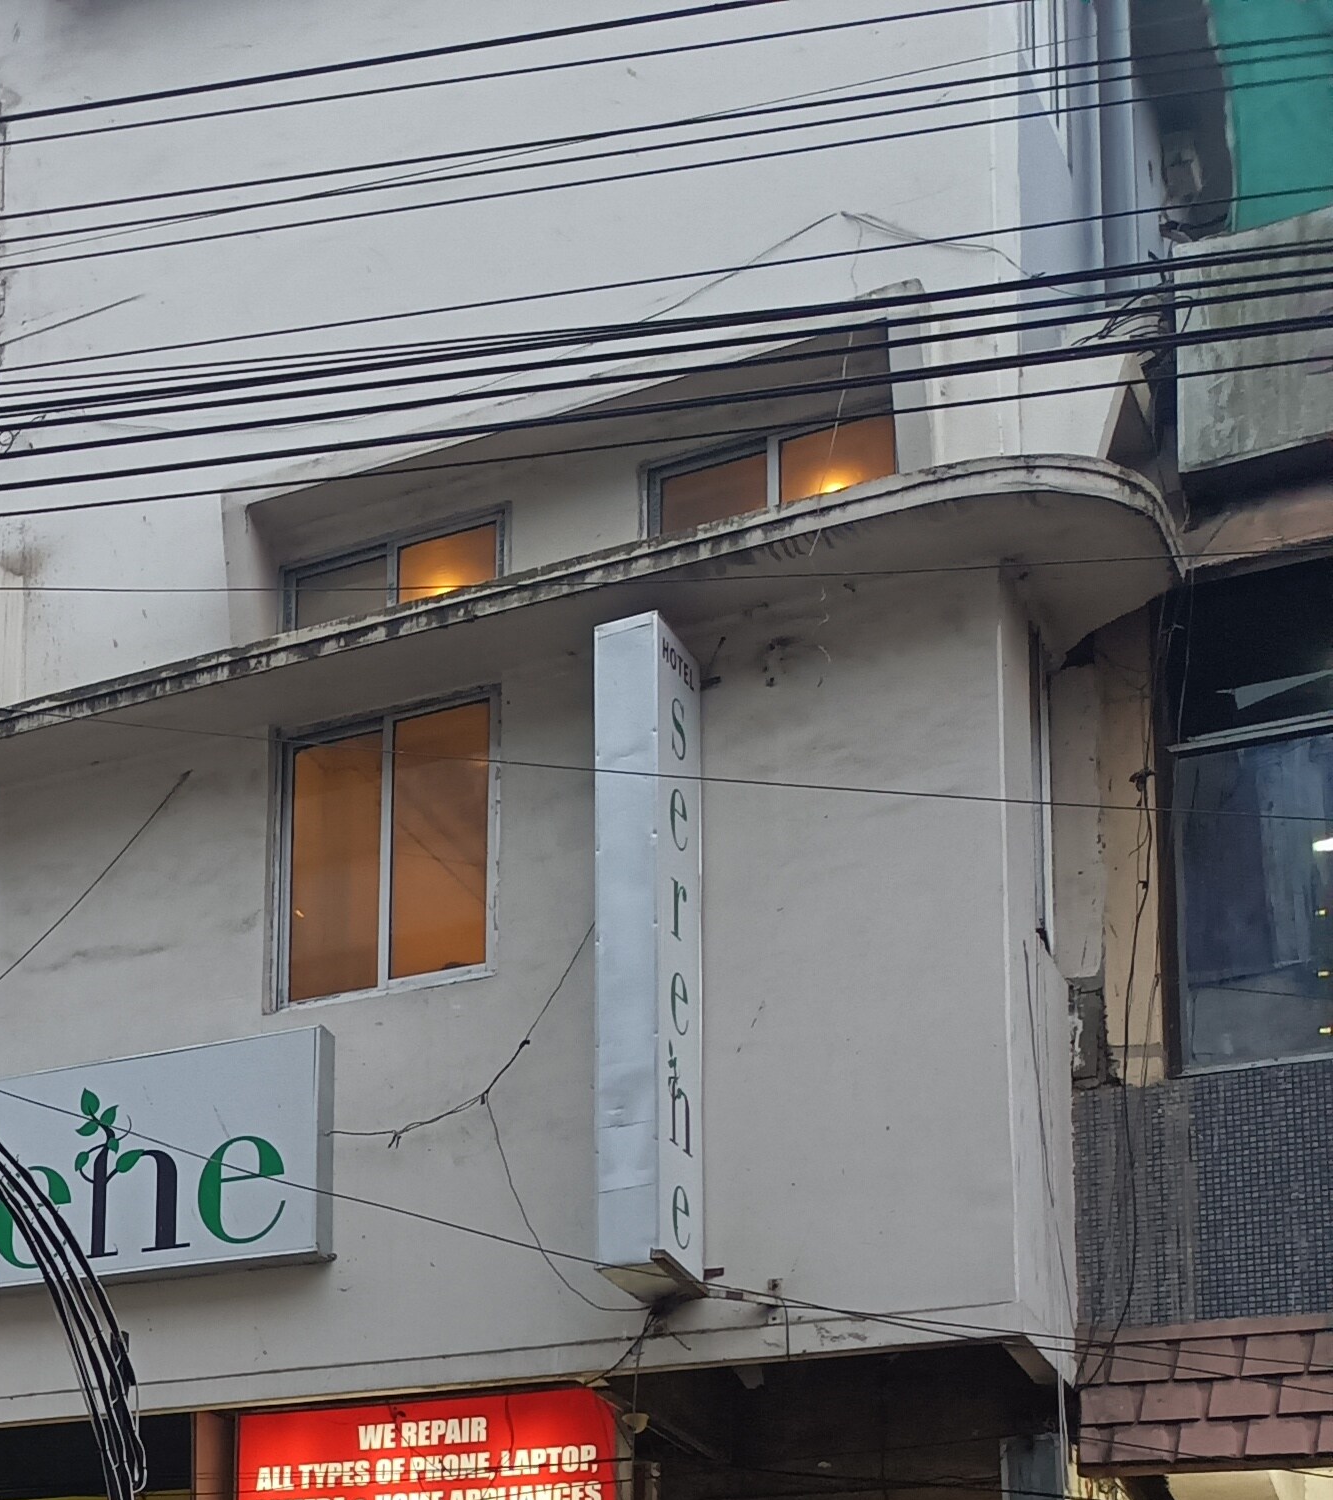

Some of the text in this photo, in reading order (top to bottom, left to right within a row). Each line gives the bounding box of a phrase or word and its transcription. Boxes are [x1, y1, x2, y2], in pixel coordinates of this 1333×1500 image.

[662, 637, 695, 692] HOTEL
[358, 1417, 487, 1450] WE REPAIR
[256, 1444, 599, 1491] ALL TYPES OF PHONE, LAPTOP,
